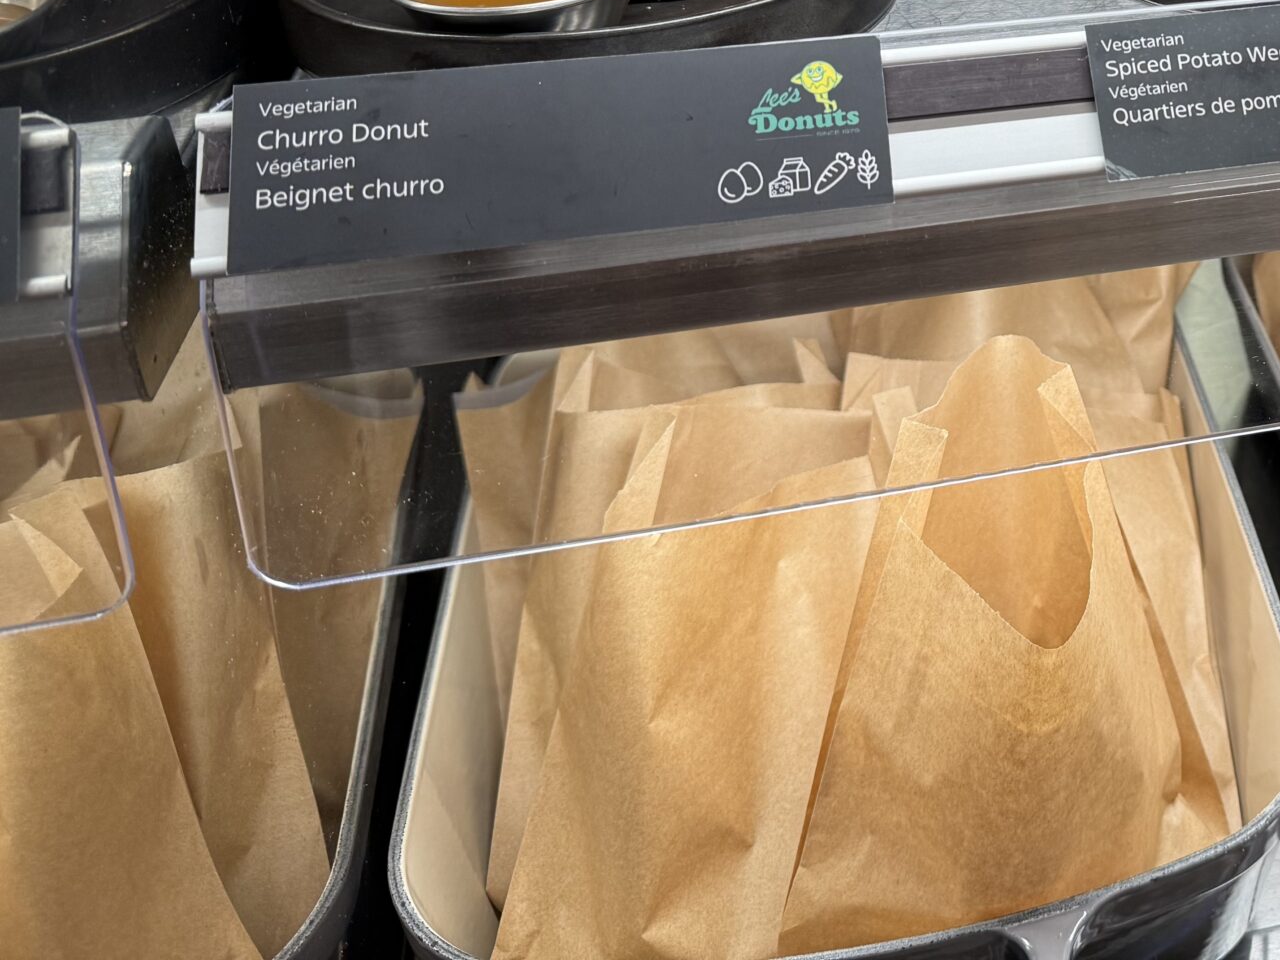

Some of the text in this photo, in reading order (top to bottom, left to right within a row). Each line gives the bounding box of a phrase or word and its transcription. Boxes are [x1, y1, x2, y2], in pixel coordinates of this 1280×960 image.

[1101, 33, 1184, 54] Vegetarian
[1104, 54, 1172, 80] Spiced
[1177, 48, 1243, 71] Potato
[751, 87, 801, 115] Lee's
[1109, 79, 1188, 101] Végétarien
[259, 96, 358, 119] Vegetarian
[1112, 97, 1206, 127] Quartiers
[1211, 96, 1236, 115] de
[257, 119, 429, 150] Churro Donut
[748, 109, 860, 134] Donuts
[256, 154, 356, 177] Végétarien
[255, 178, 445, 211] Beignet churro
